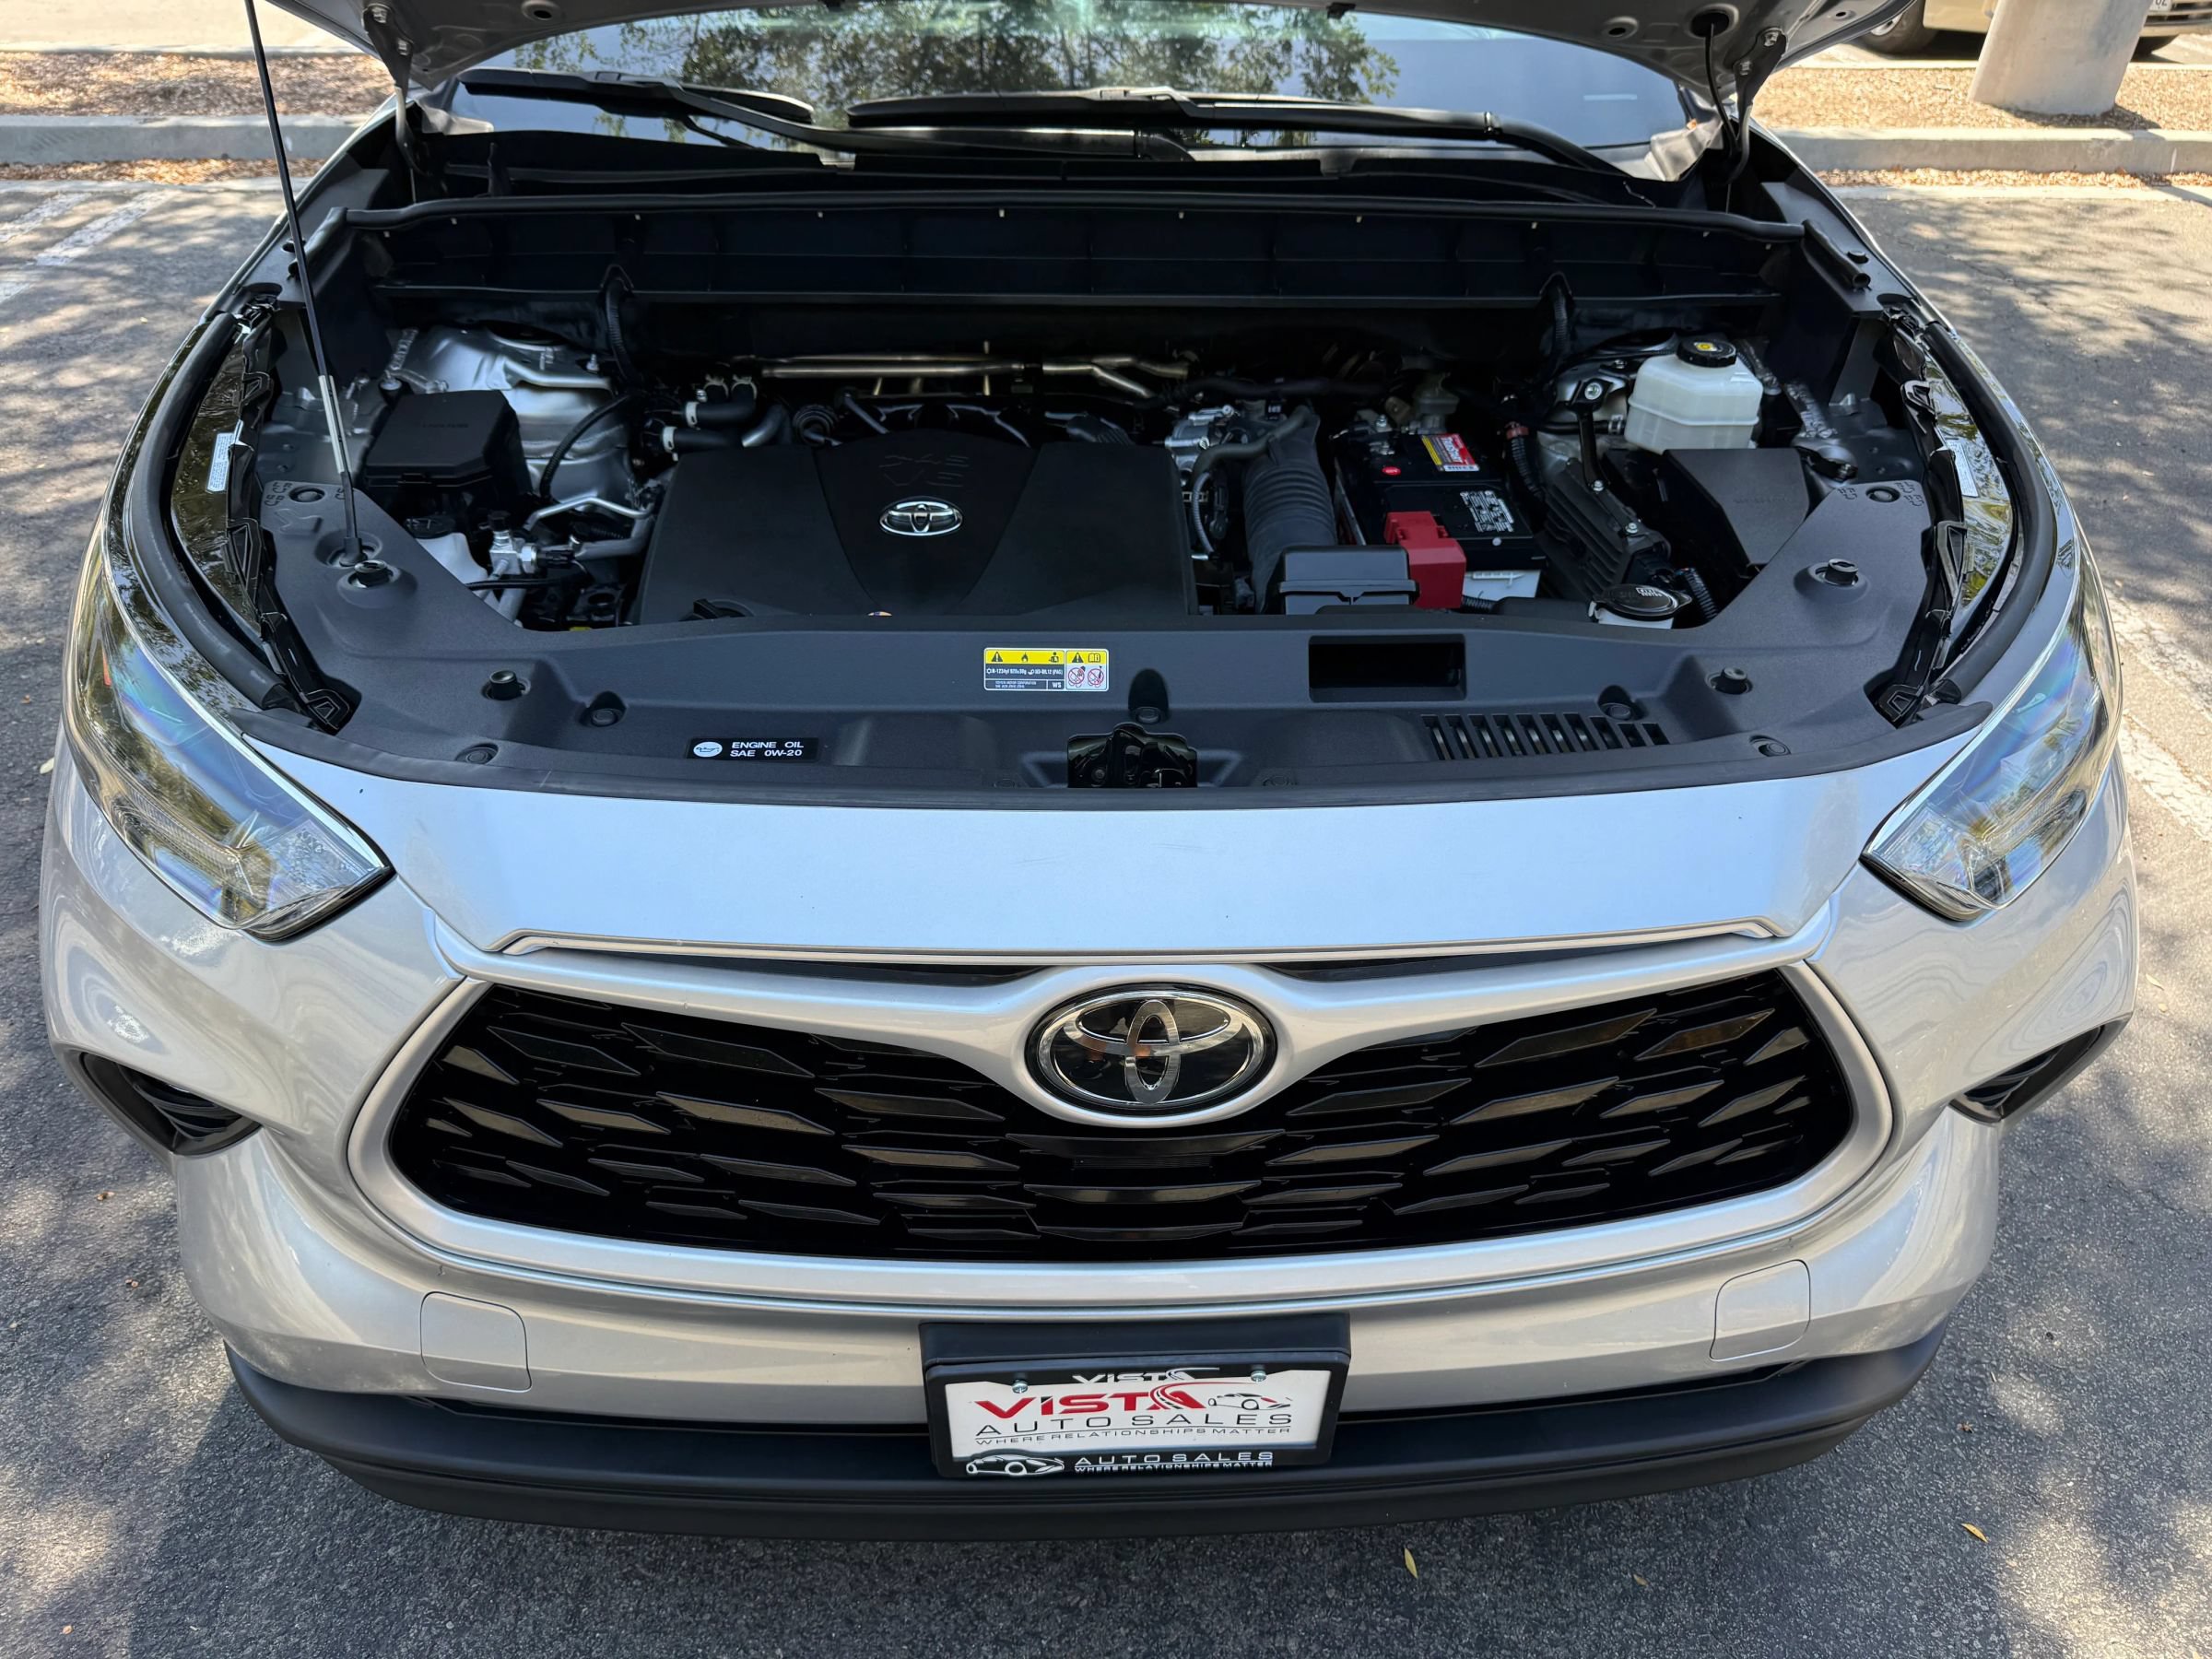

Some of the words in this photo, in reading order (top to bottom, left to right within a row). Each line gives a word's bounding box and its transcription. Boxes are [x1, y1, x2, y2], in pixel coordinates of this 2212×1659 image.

[974, 1382, 1207, 1419] VISTA
[975, 1417, 1112, 1437] AUTO
[1131, 1413, 1292, 1426] SALES
[975, 1435, 1046, 1445] WHERE
[1051, 1428, 1206, 1441] RELATIONSHIPS
[1075, 1454, 1160, 1465] AUTO
[1171, 1452, 1274, 1463] SALES
